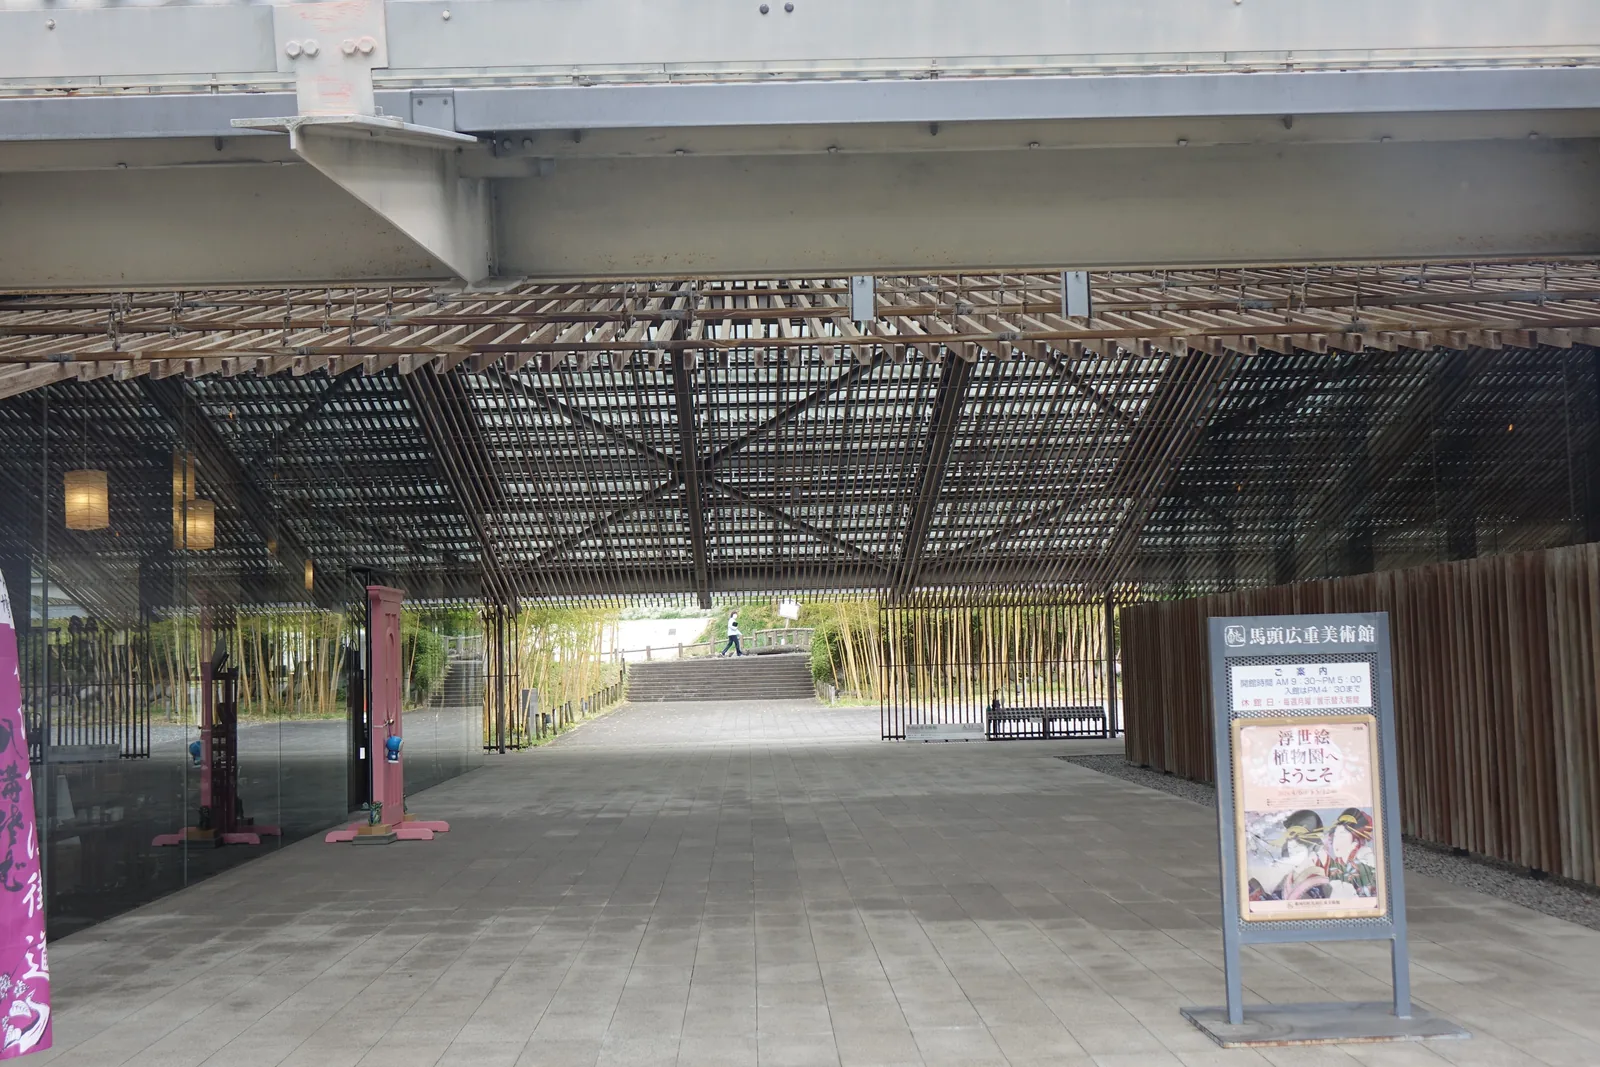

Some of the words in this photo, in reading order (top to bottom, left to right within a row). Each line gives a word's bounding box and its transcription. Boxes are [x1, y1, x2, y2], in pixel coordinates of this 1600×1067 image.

[1250, 624, 1375, 645] 馬頭広重美術館
[1278, 728, 1330, 746] 浮世絵
[1273, 748, 1339, 766] 植物園へ
[1279, 768, 1333, 784] ようこそ
